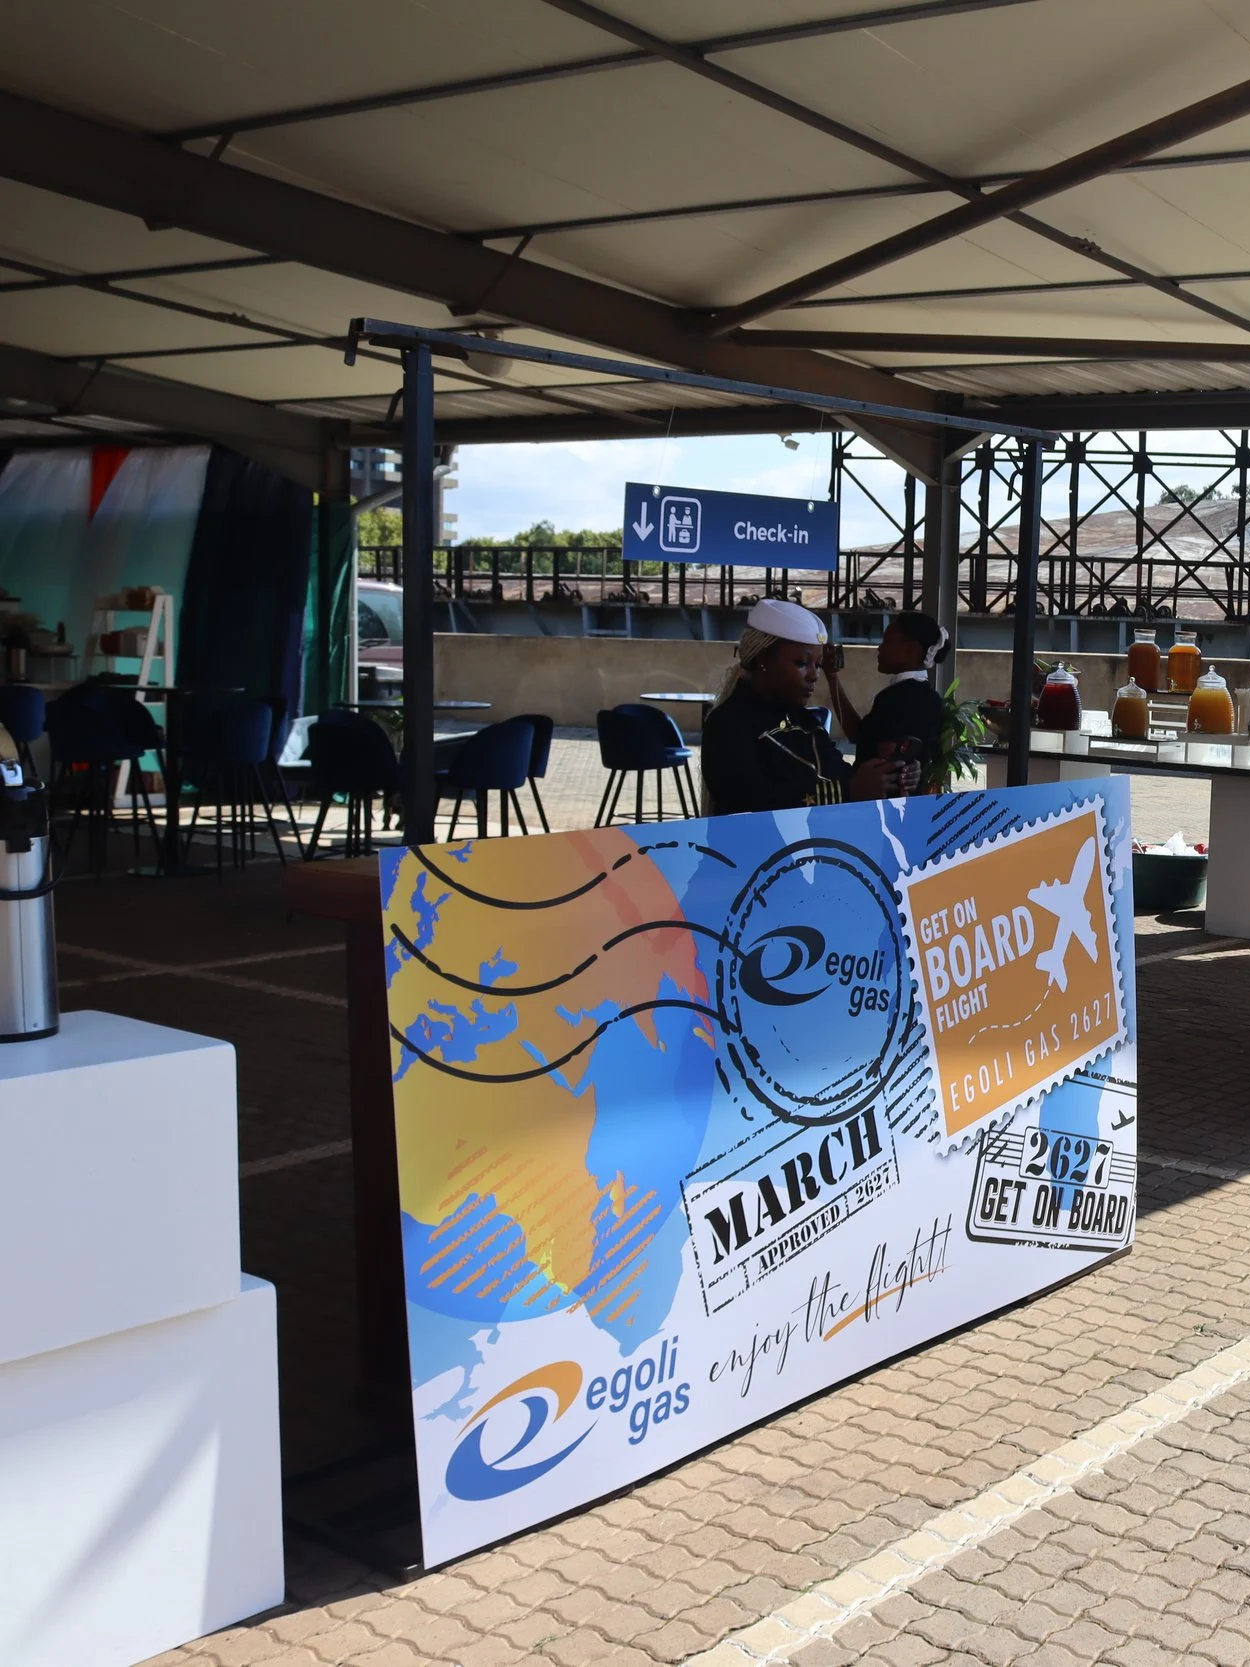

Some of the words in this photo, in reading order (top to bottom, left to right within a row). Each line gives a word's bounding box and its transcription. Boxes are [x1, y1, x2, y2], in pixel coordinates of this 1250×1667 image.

[734, 521, 809, 544] Check-in
[920, 907, 950, 943] GET
[952, 896, 978, 927] ON
[825, 946, 885, 989] egoli
[925, 905, 1035, 1001] BOARD
[848, 981, 890, 1017] gas
[936, 983, 990, 1033] FLIGHT
[949, 1056, 1014, 1113] EGOLI
[1025, 1029, 1063, 1068] GAS
[1070, 993, 1113, 1042] 2627
[704, 1105, 883, 1266] MARCH
[1025, 1131, 1111, 1186] 2627
[757, 1204, 841, 1275] APPROVED
[855, 1166, 891, 1205] 2627
[980, 1176, 1027, 1226] GET
[1032, 1184, 1065, 1229] ON
[1067, 1188, 1129, 1236] BOARD
[709, 1316, 798, 1398] enjoy
[795, 1278, 864, 1342] the
[585, 1335, 681, 1415] egoli
[627, 1381, 691, 1446] gas
